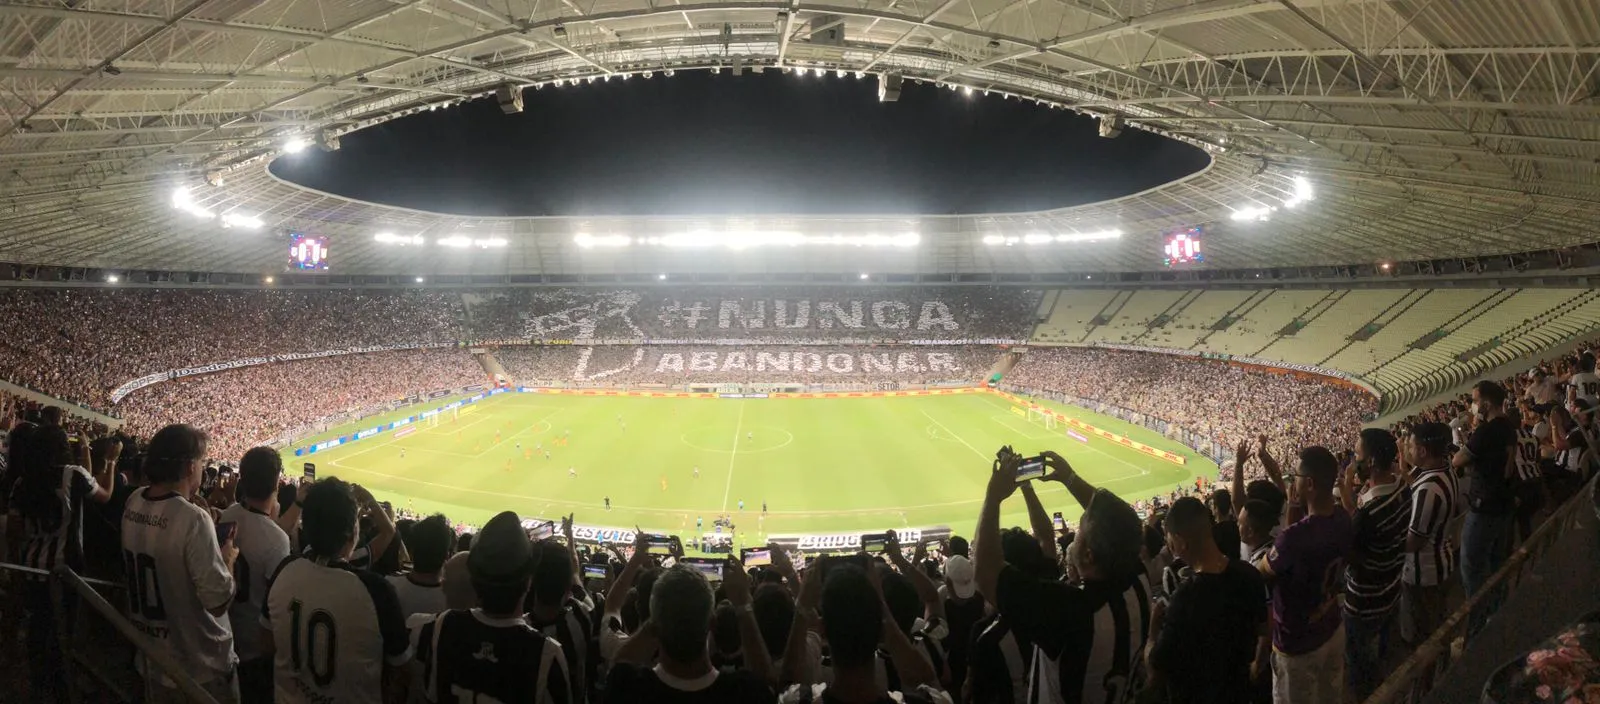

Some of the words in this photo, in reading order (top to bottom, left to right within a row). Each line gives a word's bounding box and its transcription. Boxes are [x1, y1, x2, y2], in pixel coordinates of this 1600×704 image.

[1582, 382, 1597, 395] 10
[124, 549, 167, 620] 10
[289, 598, 337, 688] 10
